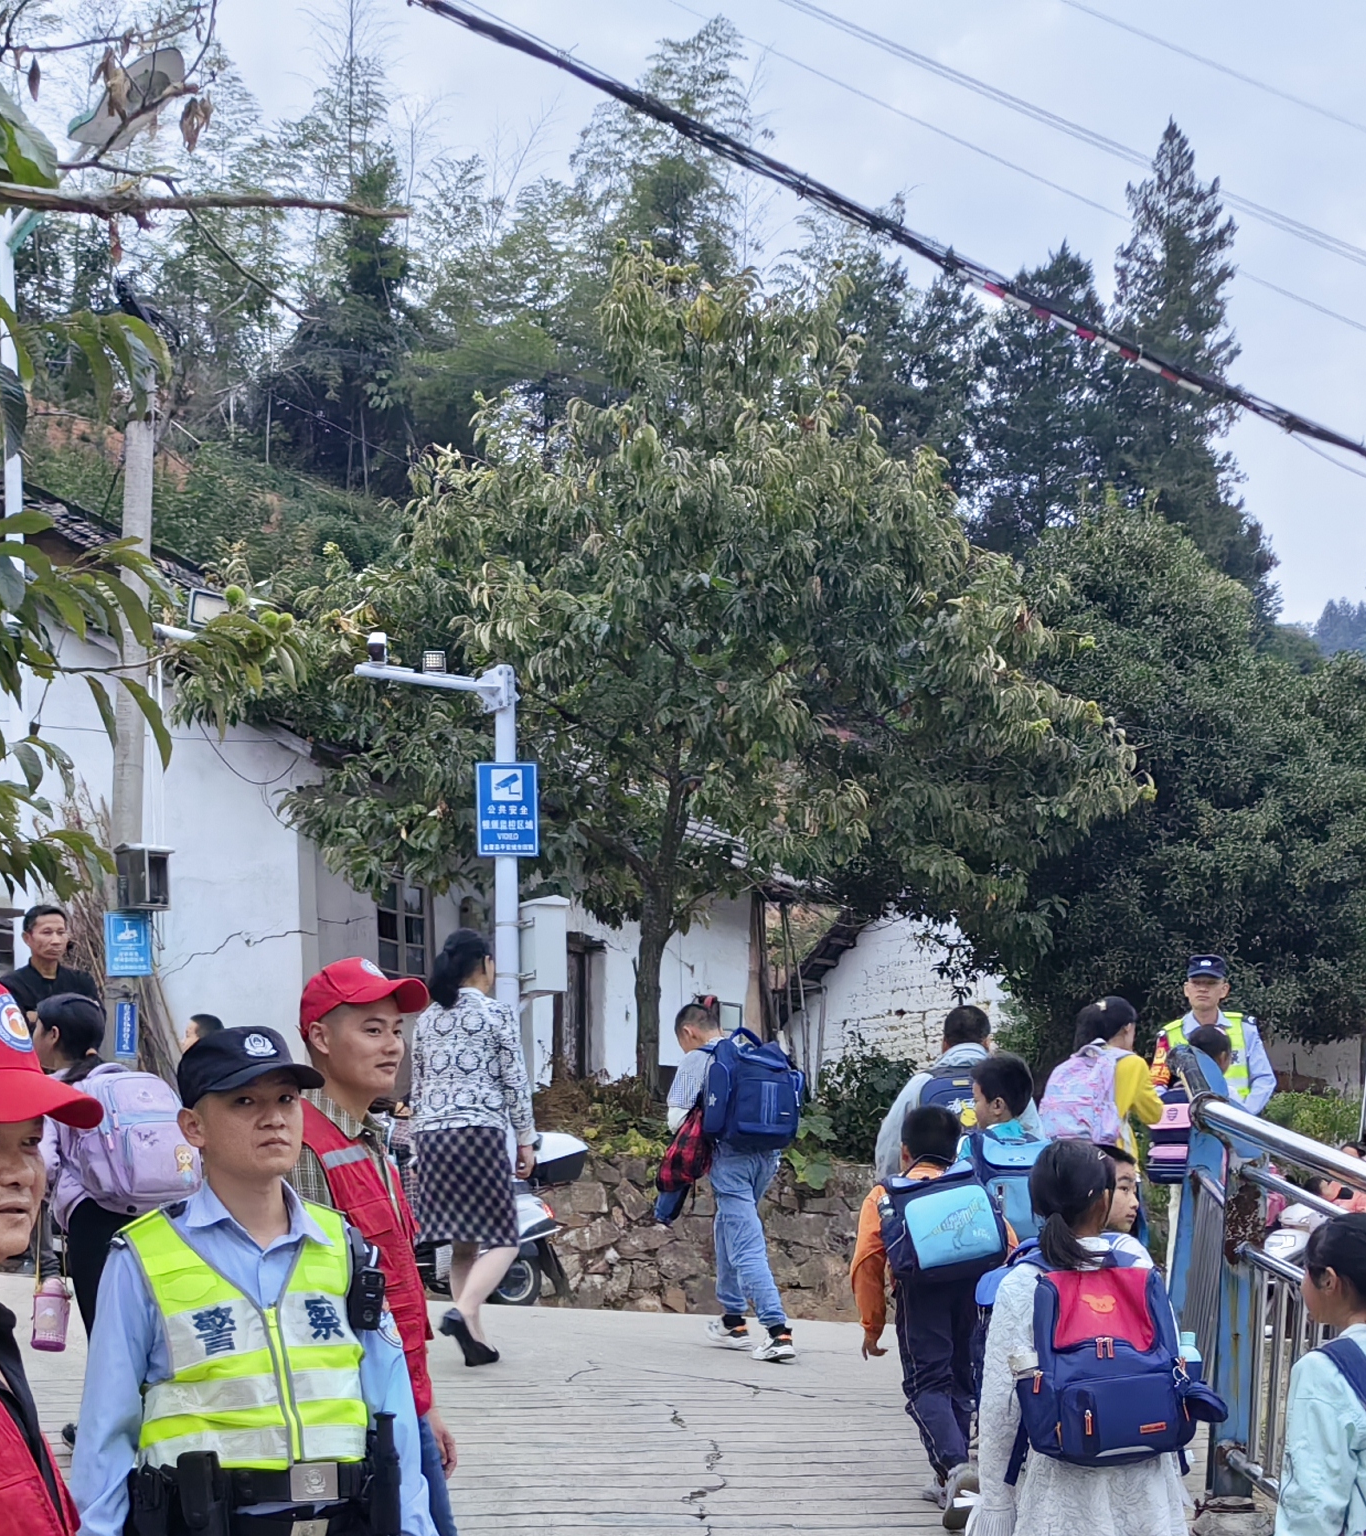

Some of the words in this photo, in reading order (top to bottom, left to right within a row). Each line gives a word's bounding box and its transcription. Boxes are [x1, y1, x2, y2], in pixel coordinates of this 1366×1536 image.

[487, 805, 528, 815] 公共安全
[191, 1306, 237, 1356] 警
[304, 1294, 346, 1341] 察
